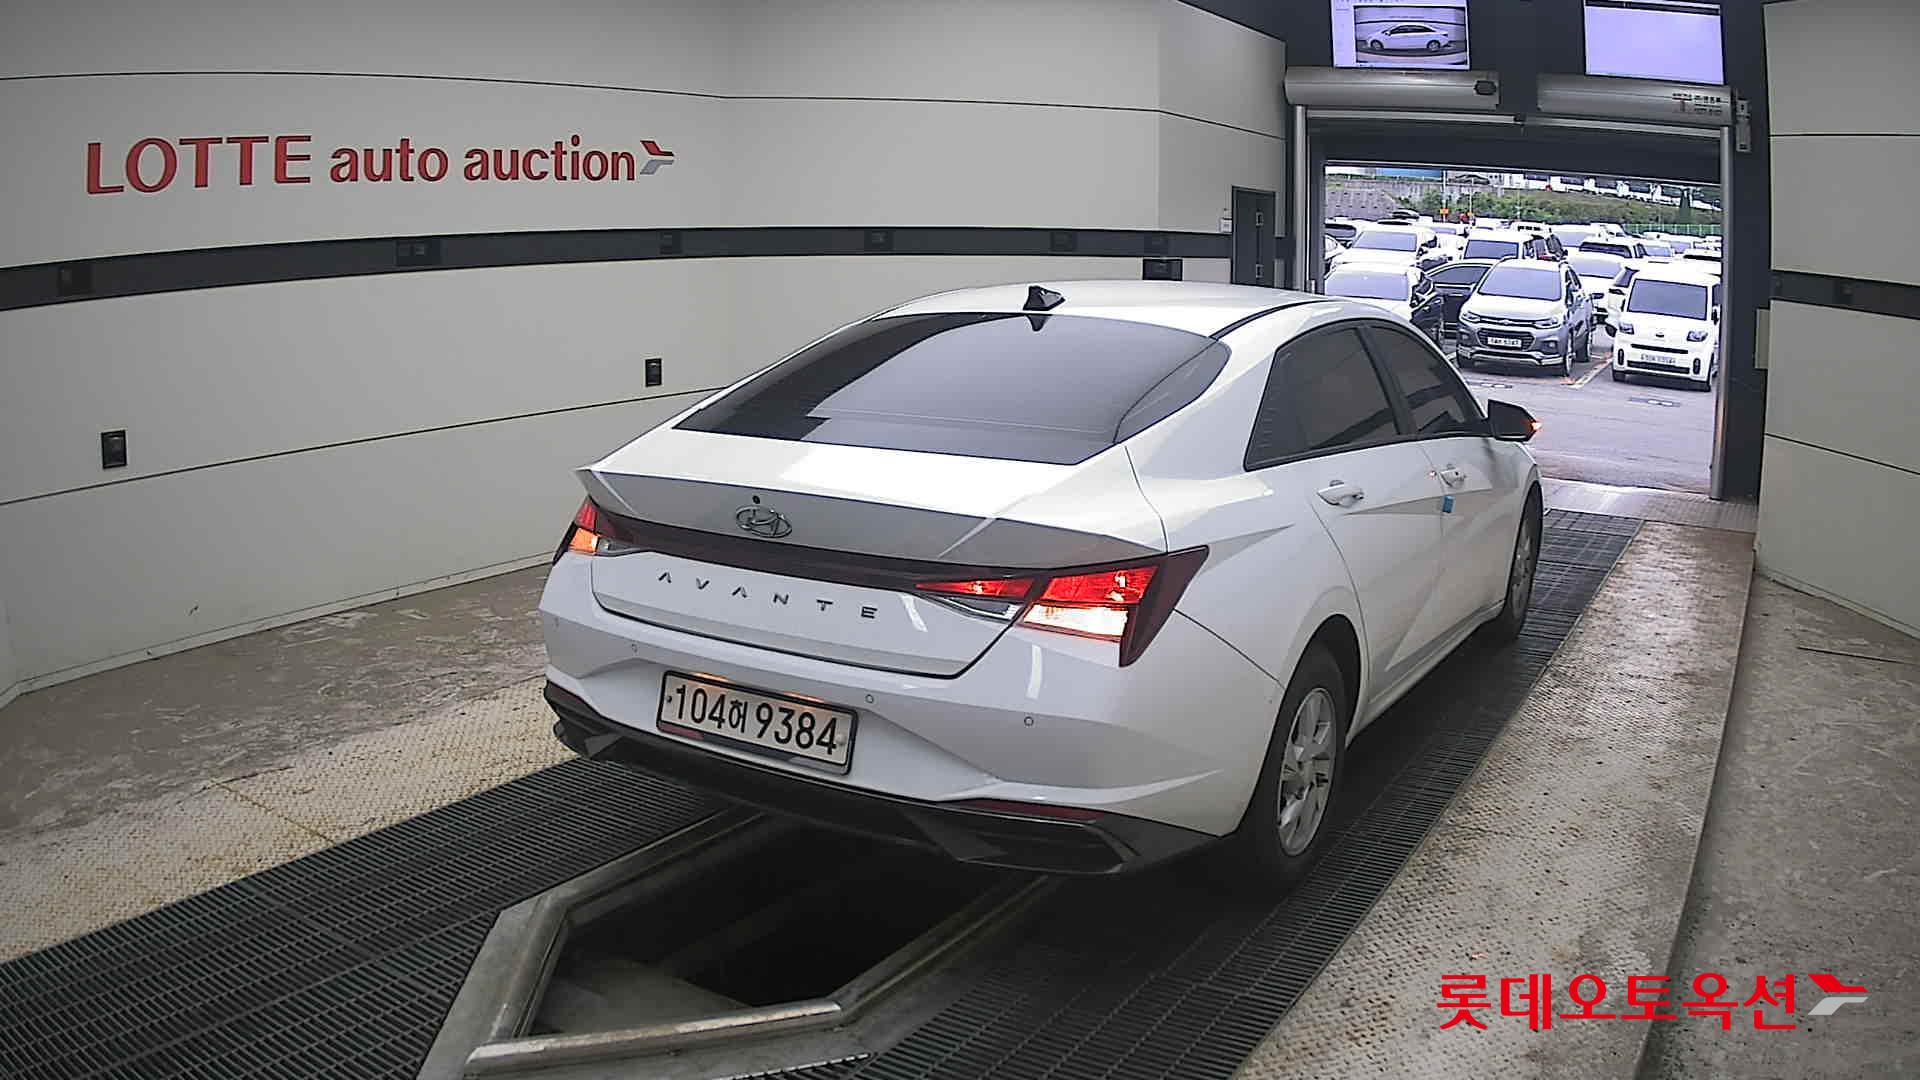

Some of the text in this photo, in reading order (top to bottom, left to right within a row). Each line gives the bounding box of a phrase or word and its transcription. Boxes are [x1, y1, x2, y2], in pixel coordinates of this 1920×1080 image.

[86, 133, 637, 195] LOTTE auto auction
[658, 571, 878, 619] AVANTE
[755, 702, 838, 755] 9384
